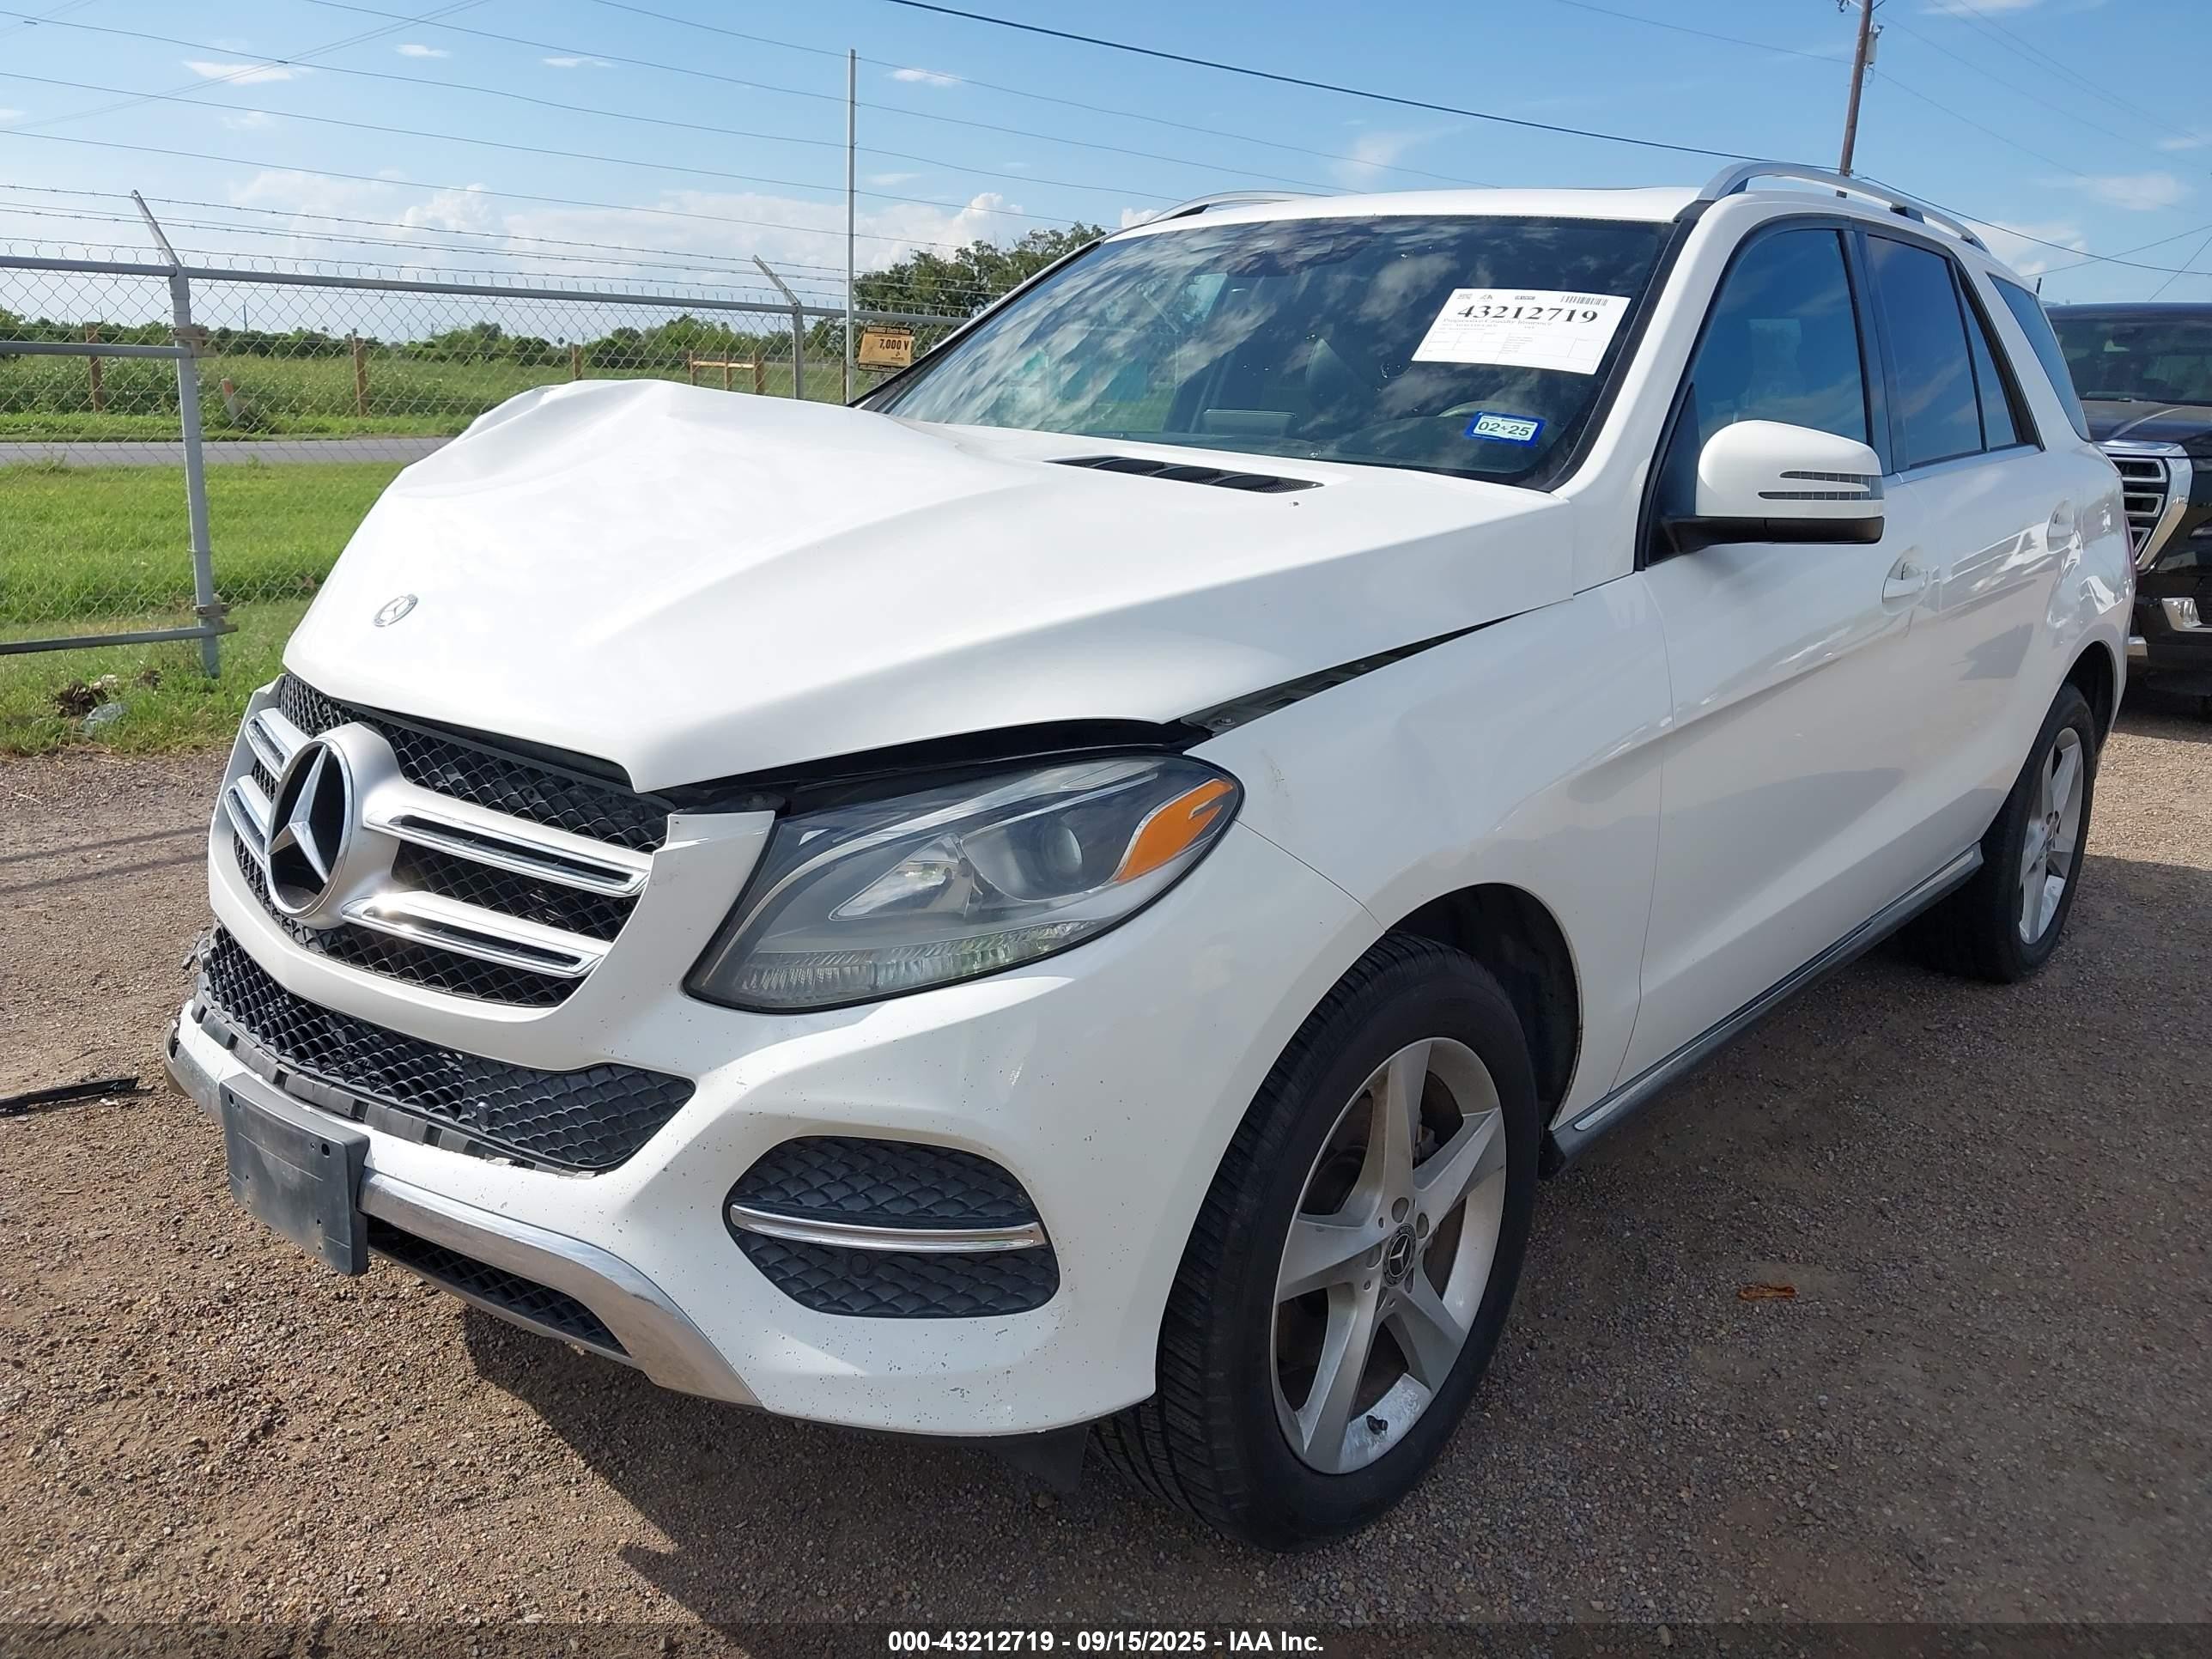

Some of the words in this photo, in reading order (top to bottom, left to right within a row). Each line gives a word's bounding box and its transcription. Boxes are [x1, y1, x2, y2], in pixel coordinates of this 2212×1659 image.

[1457, 305, 1599, 324] 43212719
[879, 338, 902, 350] 7,000
[904, 340, 909, 350] V
[1478, 421, 1500, 432] 02
[1508, 425, 1531, 436] 25
